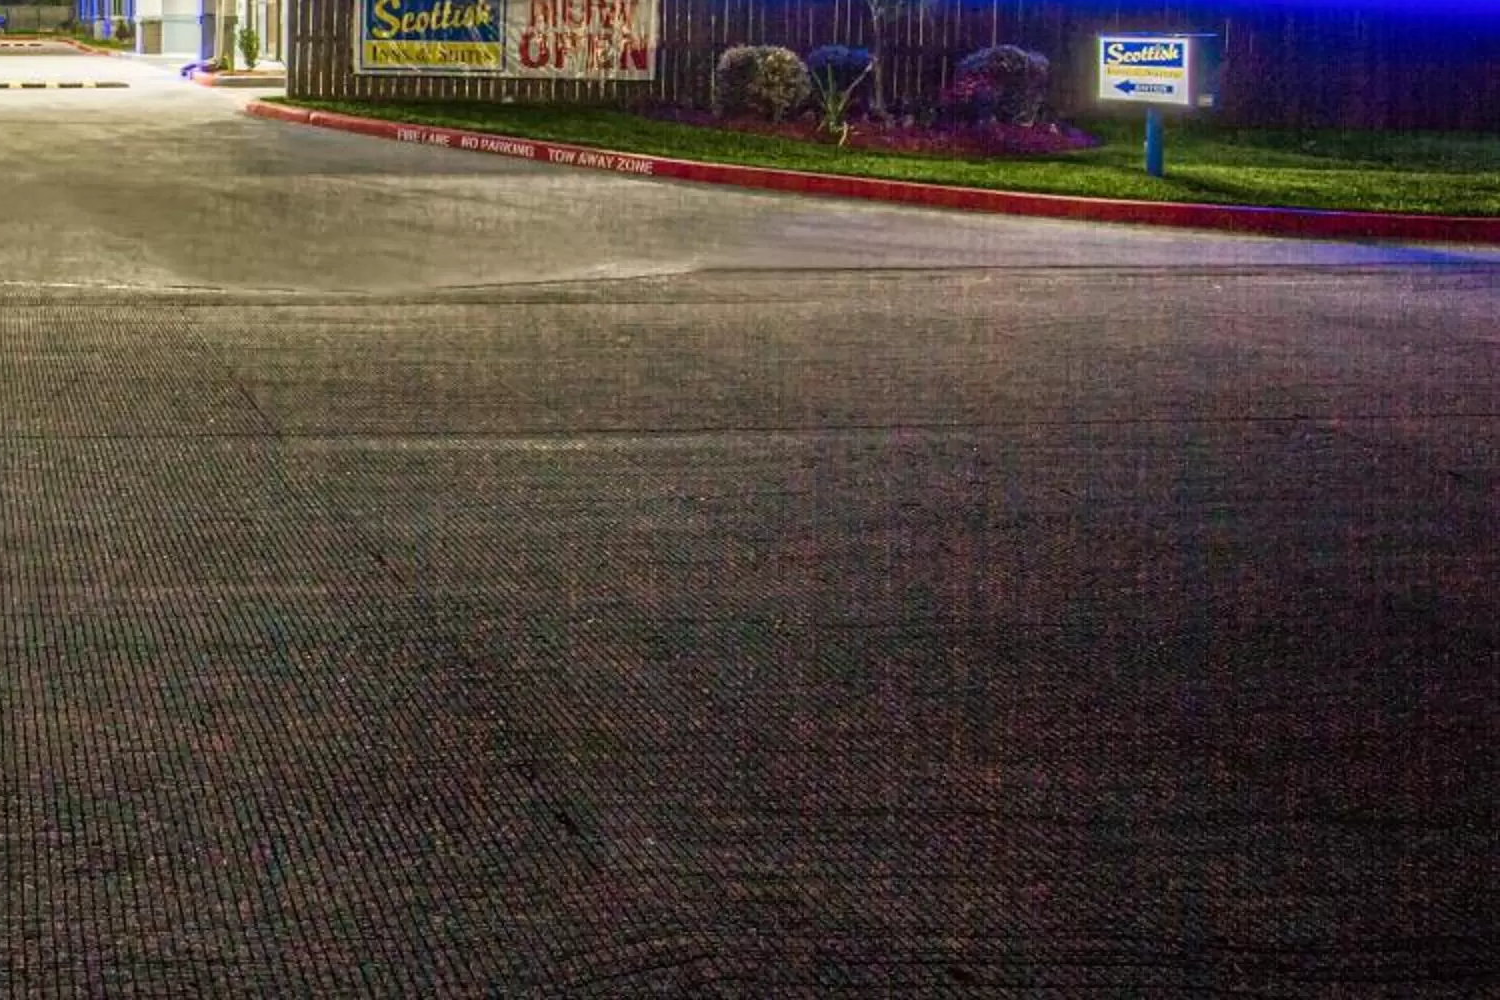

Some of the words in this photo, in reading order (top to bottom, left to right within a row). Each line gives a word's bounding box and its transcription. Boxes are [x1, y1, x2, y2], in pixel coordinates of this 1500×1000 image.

[1106, 42, 1179, 65] Scottish
[461, 135, 479, 149] NO
[481, 138, 535, 157] PARKING
[547, 147, 577, 162] TOW
[578, 151, 614, 169] AWAY
[616, 157, 654, 175] ZONE
